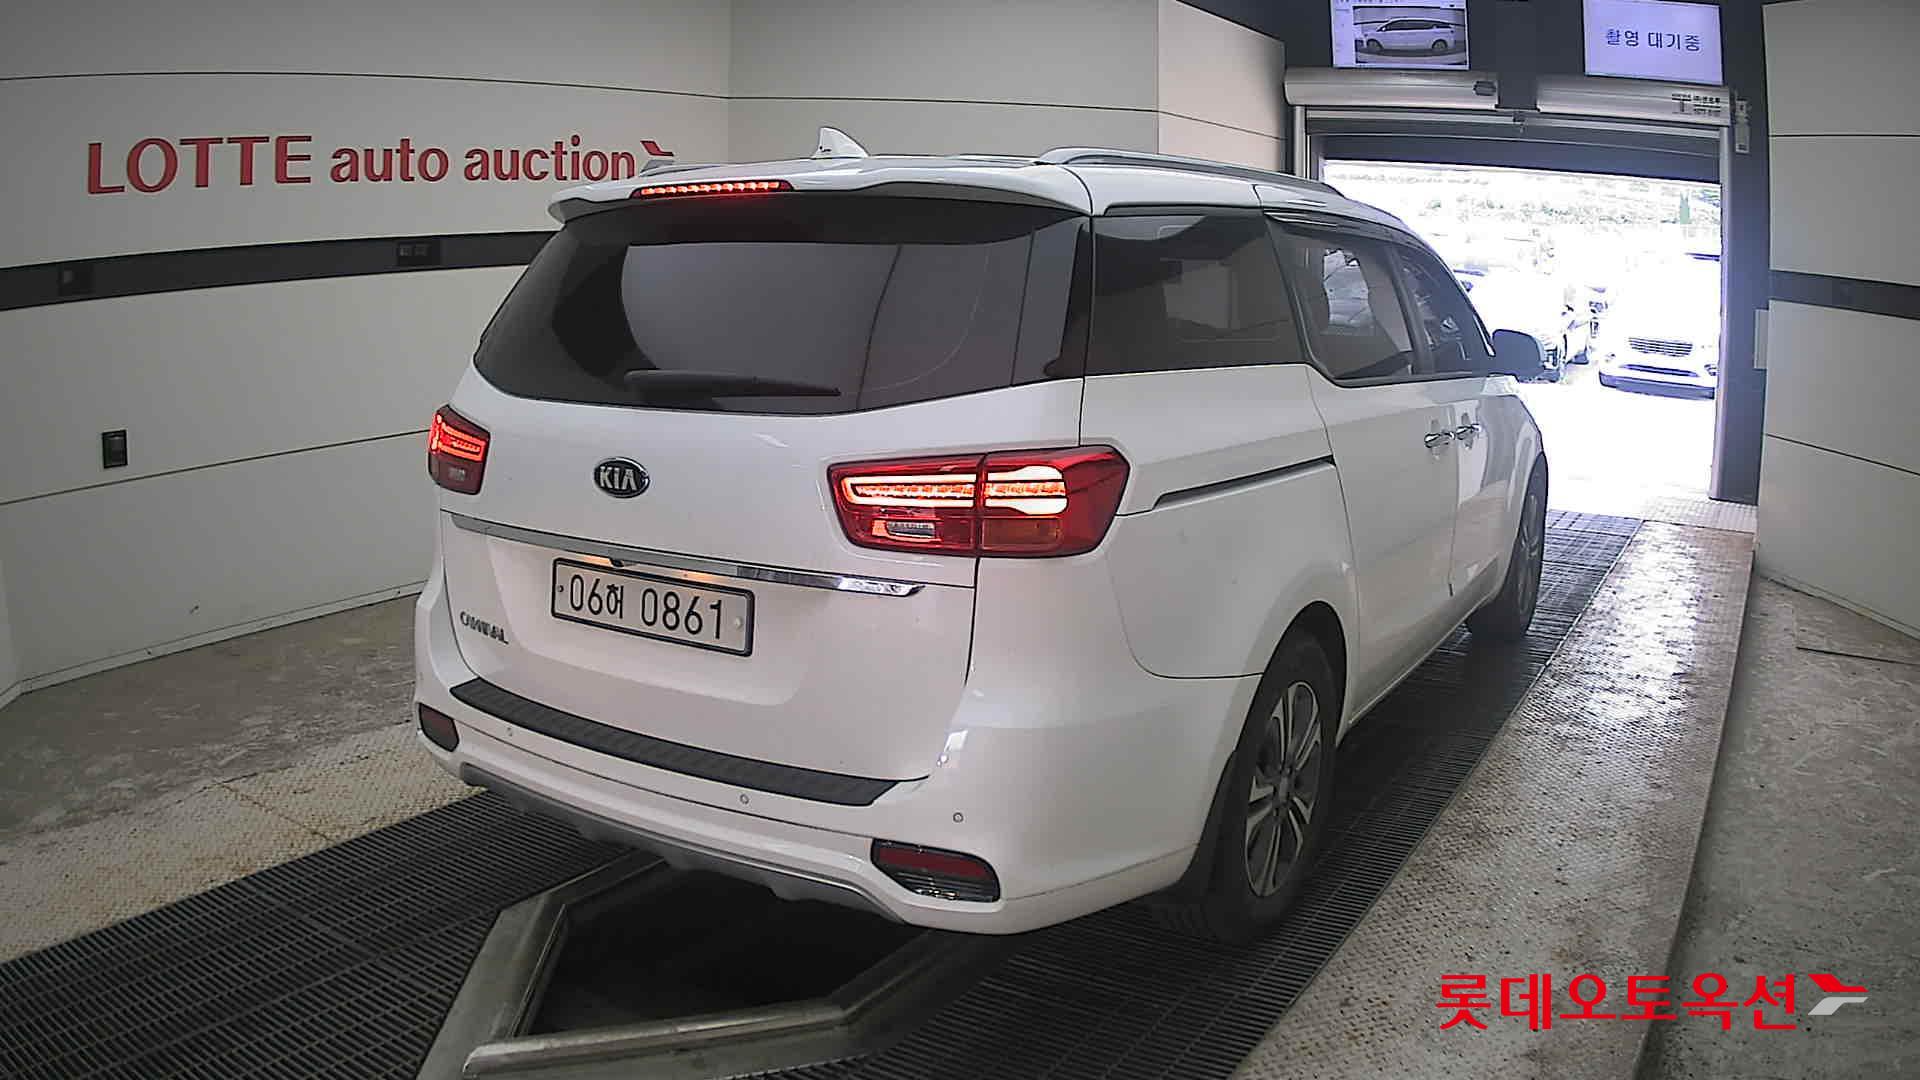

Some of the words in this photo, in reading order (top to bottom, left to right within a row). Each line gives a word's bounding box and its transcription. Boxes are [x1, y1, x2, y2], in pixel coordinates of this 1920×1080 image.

[1606, 28, 1640, 47] 촬영
[1647, 31, 1701, 52] 대기중
[87, 135, 312, 195] LOTTE
[330, 138, 449, 183] auto
[463, 135, 635, 182] auction
[599, 465, 639, 491] KIA
[569, 574, 625, 619] 06허
[641, 587, 723, 639] 0861
